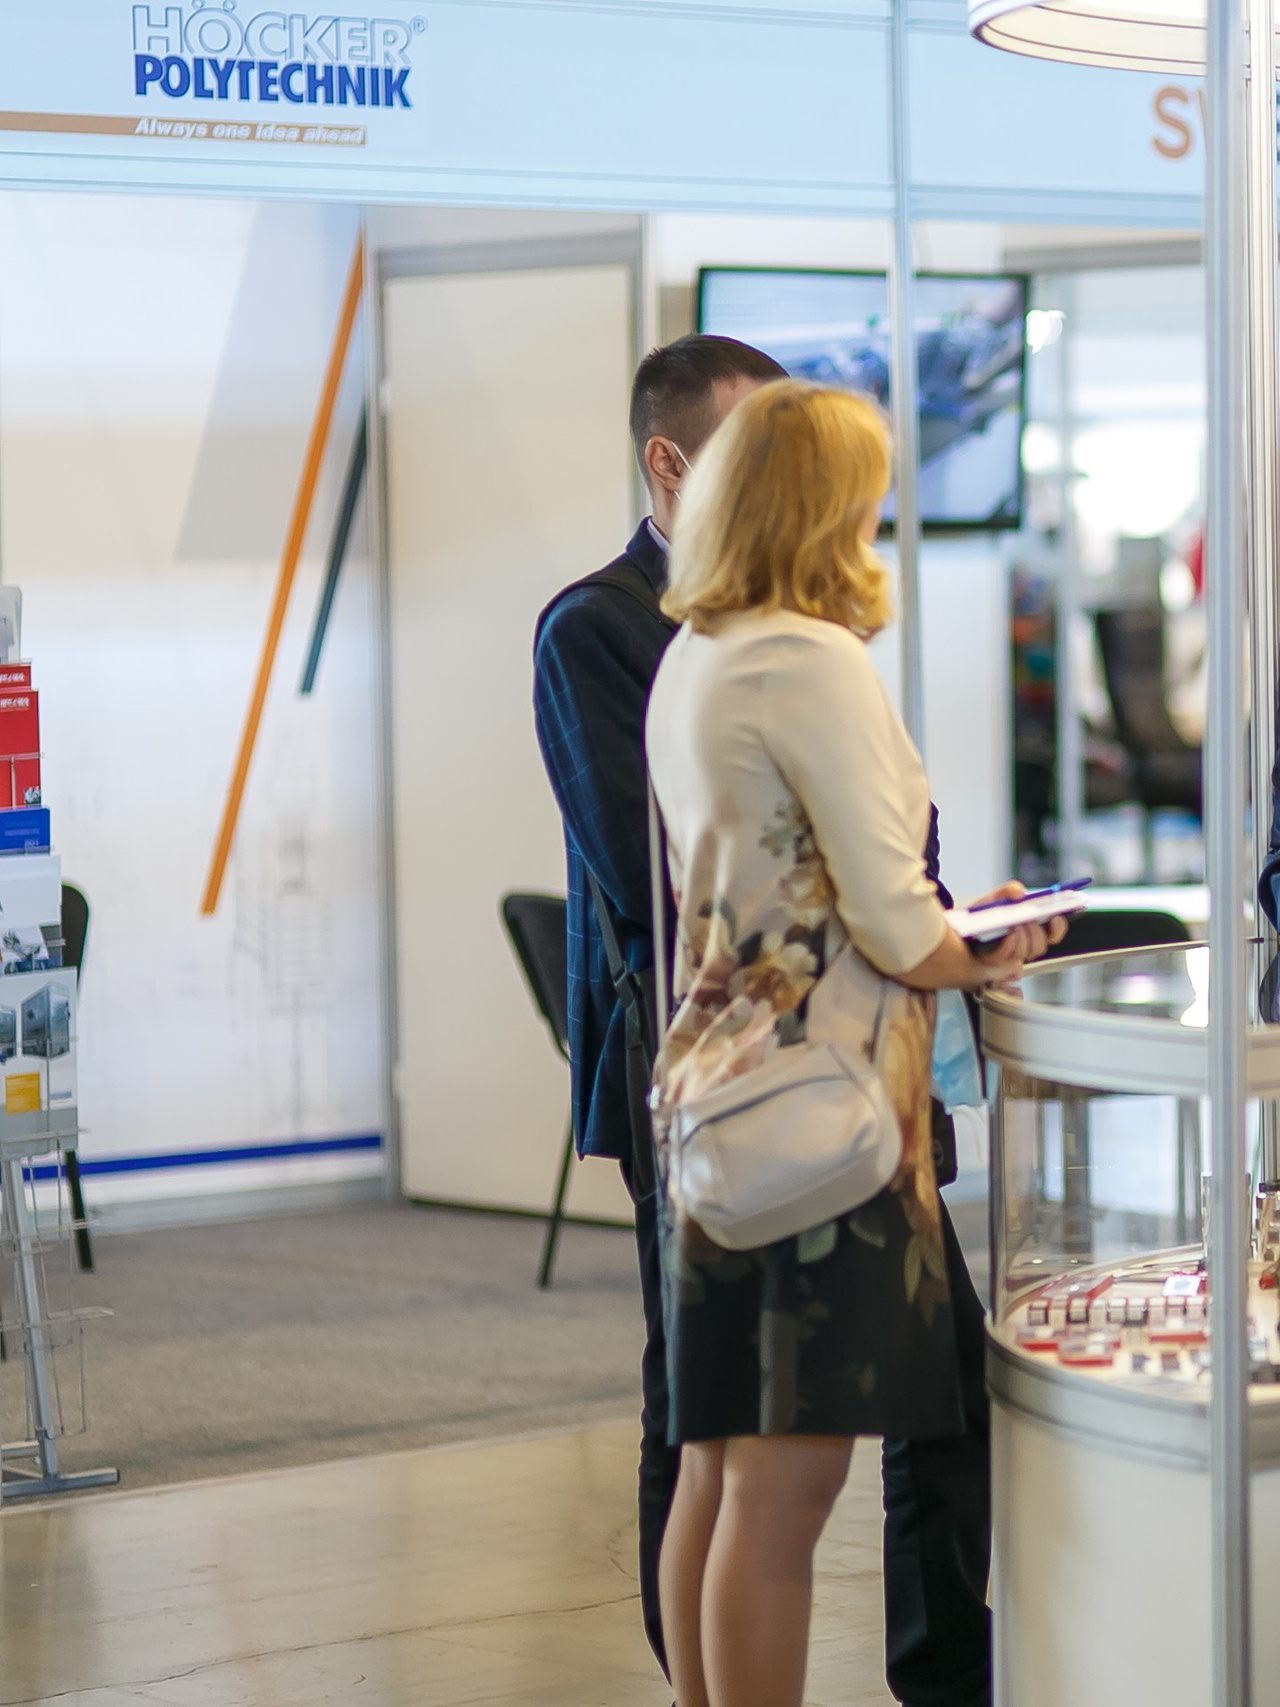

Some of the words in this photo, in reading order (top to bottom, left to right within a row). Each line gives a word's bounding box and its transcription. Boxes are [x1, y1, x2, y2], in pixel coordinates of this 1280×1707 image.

[133, 52, 413, 109] POLYTECHNIK
[134, 116, 208, 140] Always
[212, 122, 250, 140] one
[254, 121, 299, 143] idea
[302, 125, 364, 145] ahead
